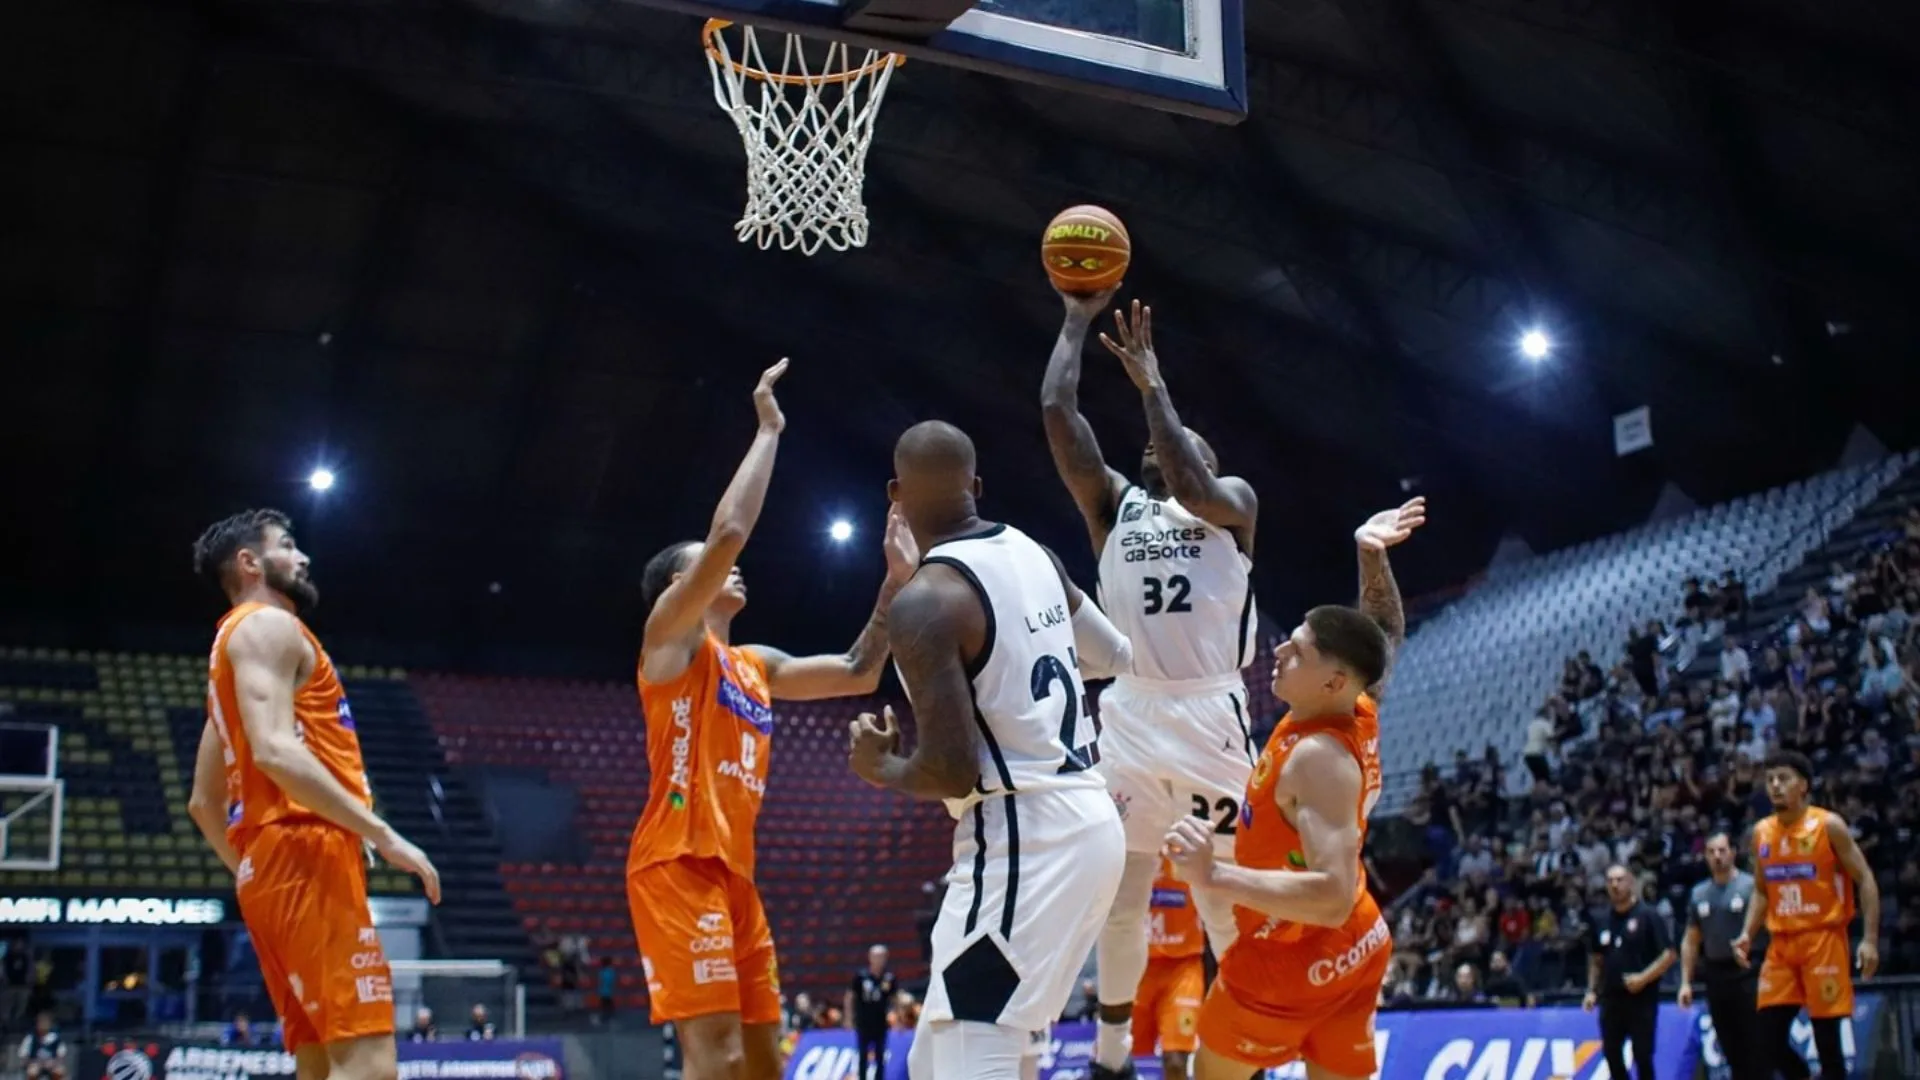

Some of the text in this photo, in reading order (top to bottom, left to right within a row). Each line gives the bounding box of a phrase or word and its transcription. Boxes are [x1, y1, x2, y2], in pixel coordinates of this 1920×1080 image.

[1047, 224, 1110, 242] PENALTY
[1121, 527, 1205, 547] Esportes
[1125, 544, 1201, 562] daSorte
[1143, 574, 1192, 615] 32
[1031, 645, 1101, 774] 2
[1192, 793, 1239, 835] 32
[66, 897, 225, 925] MARQUES
[164, 1047, 298, 1075] ARREMESS
